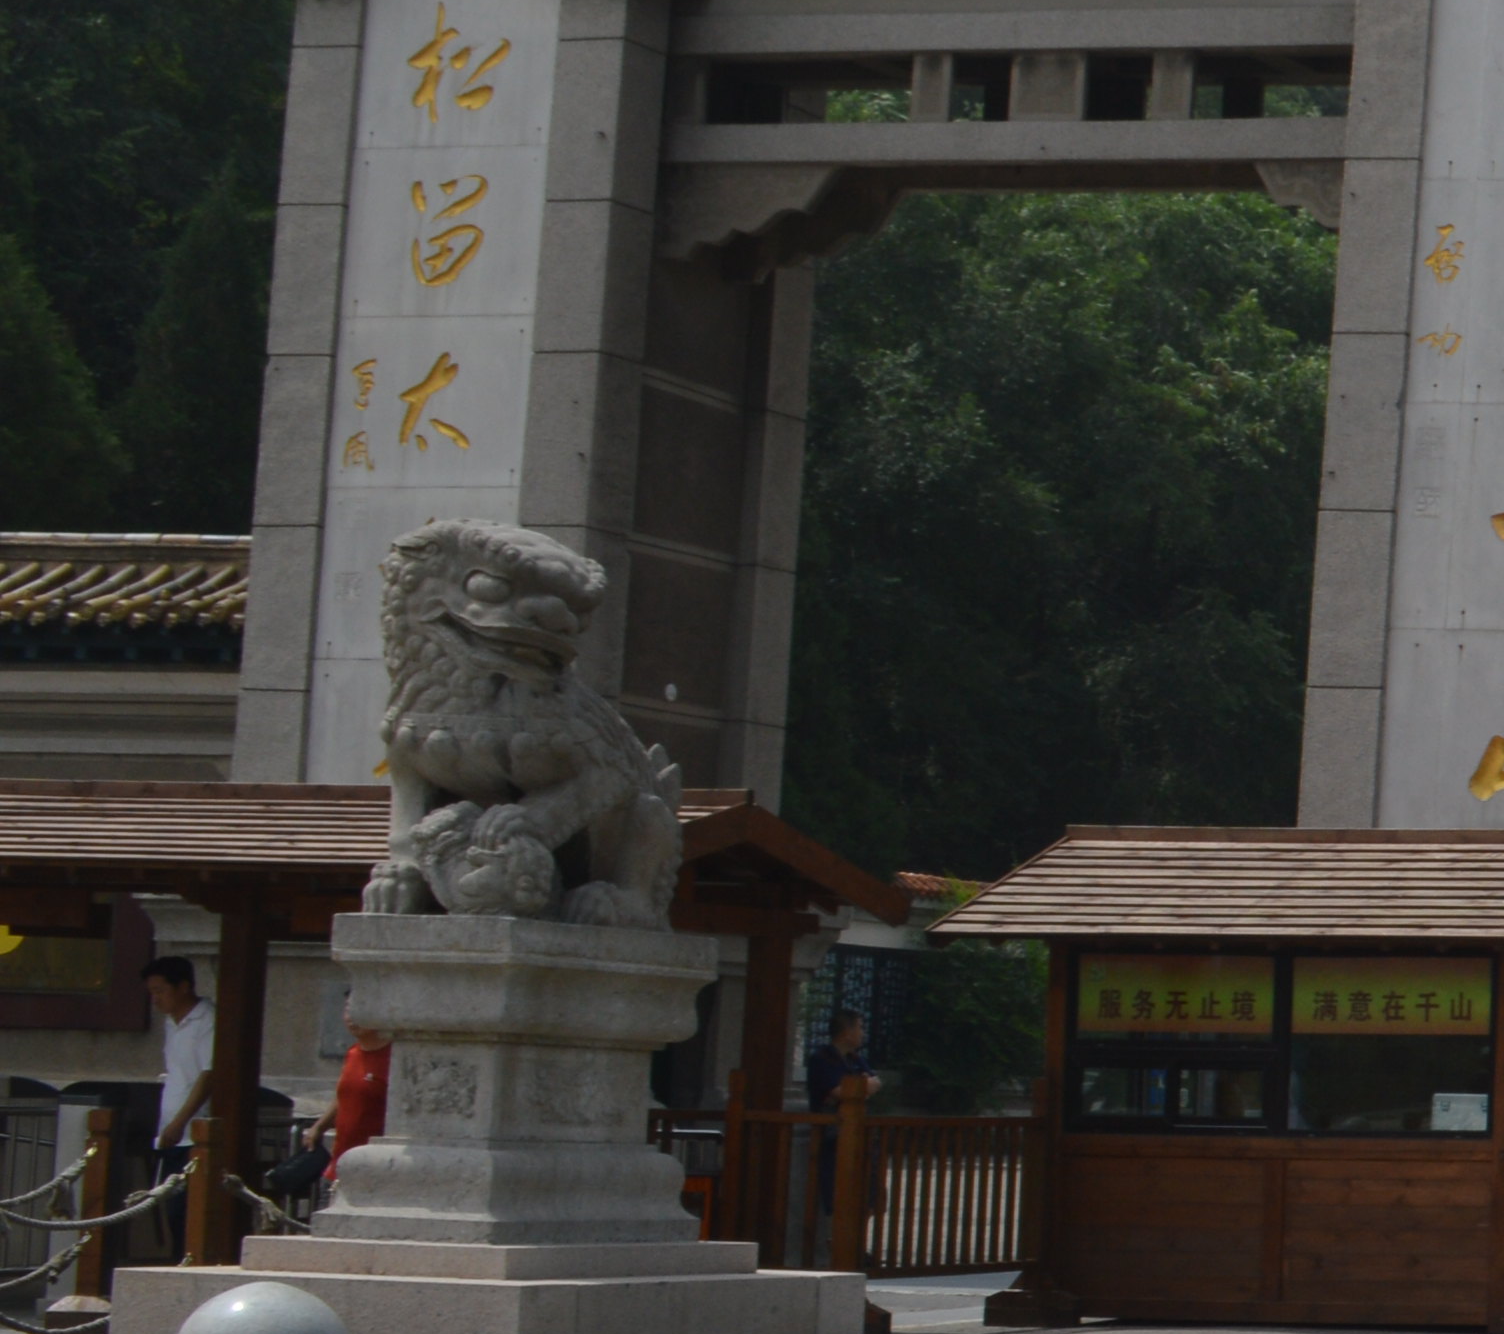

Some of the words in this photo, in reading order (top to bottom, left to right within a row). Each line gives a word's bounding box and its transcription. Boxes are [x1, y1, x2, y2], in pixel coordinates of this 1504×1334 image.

[1097, 988, 1257, 1022] 服务无止境
[1312, 990, 1473, 1023] 满意在千山
